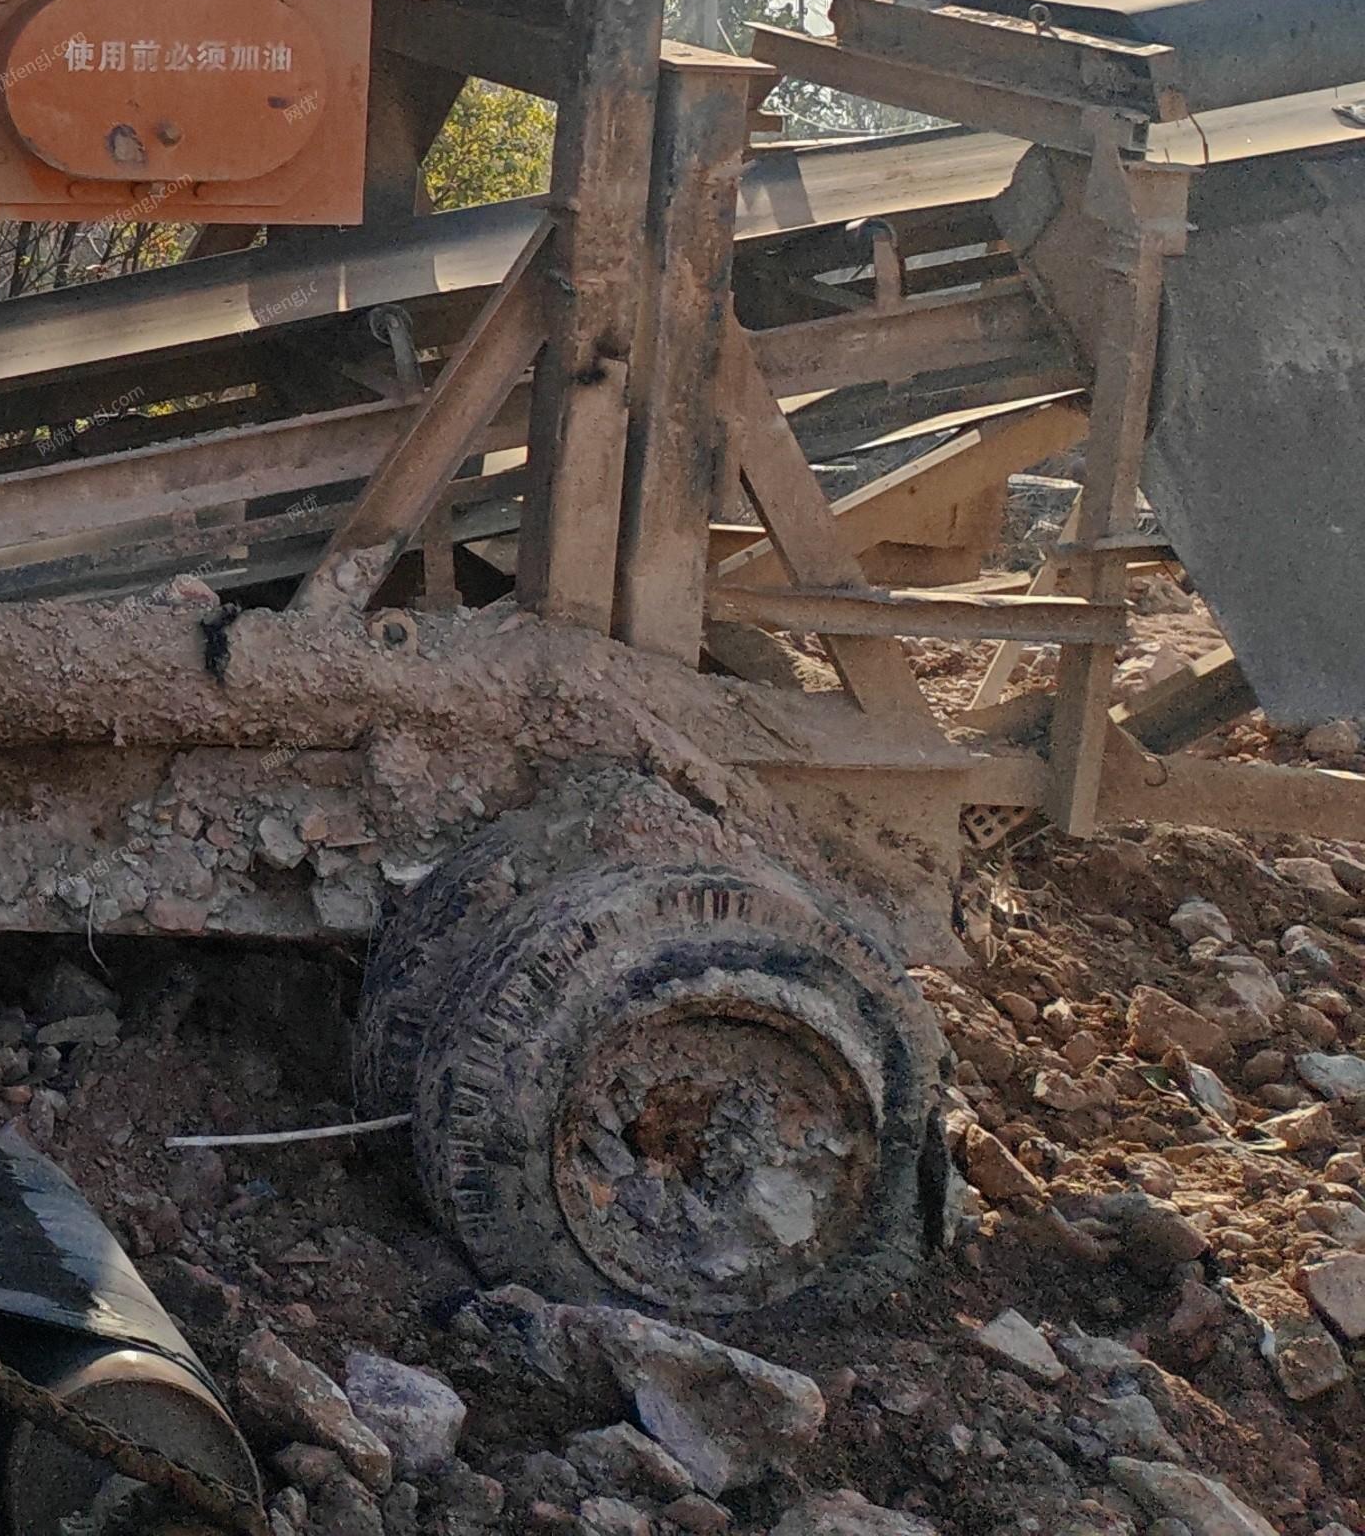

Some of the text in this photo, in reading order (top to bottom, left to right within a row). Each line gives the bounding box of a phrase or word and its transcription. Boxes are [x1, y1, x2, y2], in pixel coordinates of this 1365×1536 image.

[64, 40, 293, 73] 使用前必须加油
